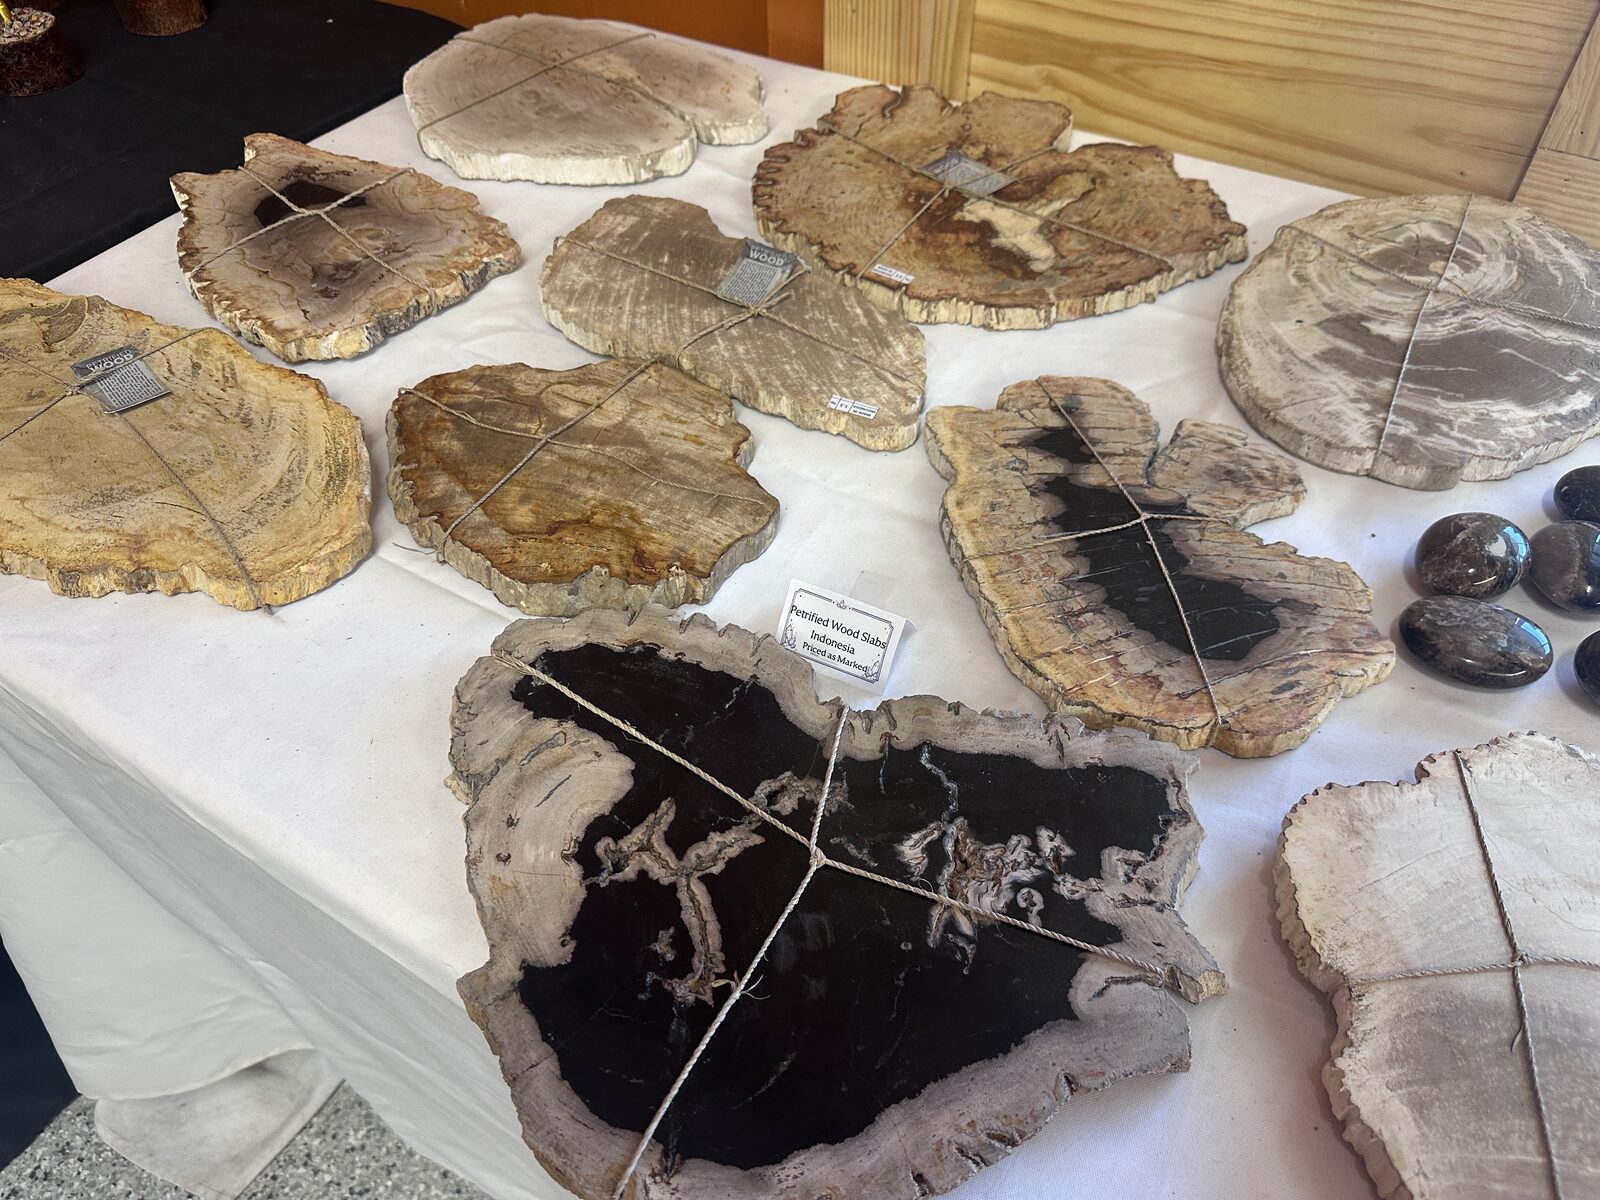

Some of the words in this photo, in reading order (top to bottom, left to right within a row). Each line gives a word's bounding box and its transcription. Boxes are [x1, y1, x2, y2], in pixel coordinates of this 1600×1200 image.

[750, 249, 784, 266] WOOD
[791, 604, 830, 627] Petrified
[831, 619, 860, 639] Wood
[860, 632, 887, 650] Slabs
[810, 629, 855, 655] Indonesia
[802, 641, 827, 657] Priced
[827, 650, 837, 661] as
[837, 655, 868, 673] Marked
